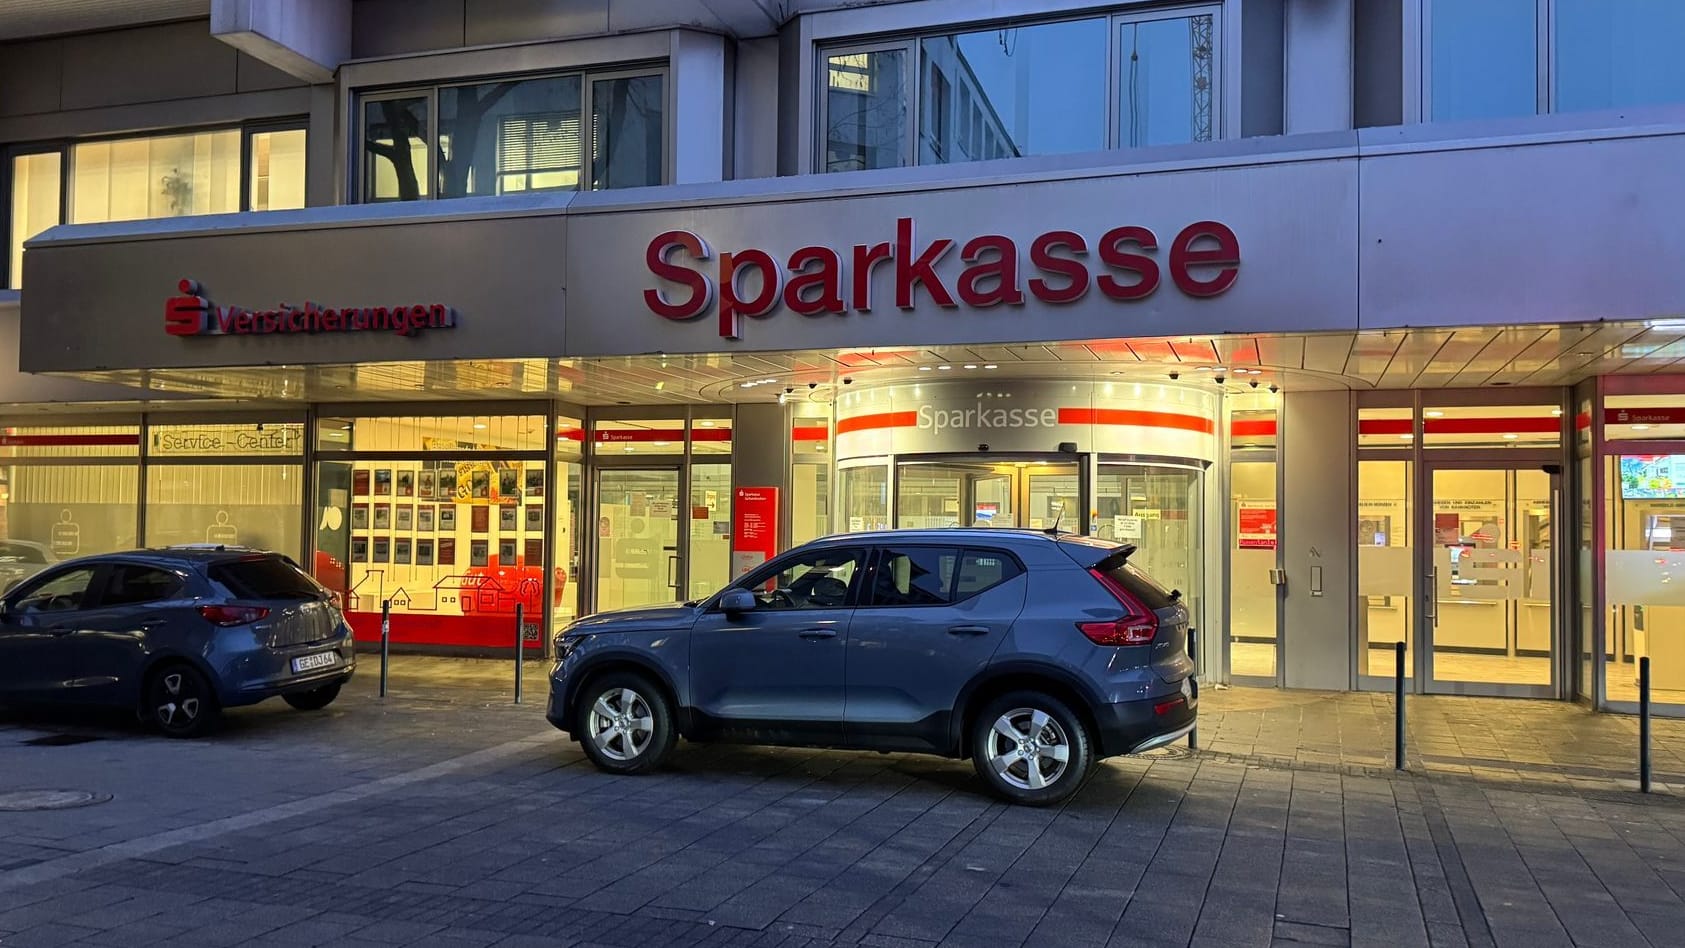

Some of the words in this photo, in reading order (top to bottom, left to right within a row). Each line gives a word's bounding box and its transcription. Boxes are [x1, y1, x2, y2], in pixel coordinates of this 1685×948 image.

[643, 217, 1241, 339] Sparkasse
[216, 301, 449, 337] Versicherungen
[918, 401, 1057, 435] Sparkasse
[1631, 414, 1671, 422] Sparkasse
